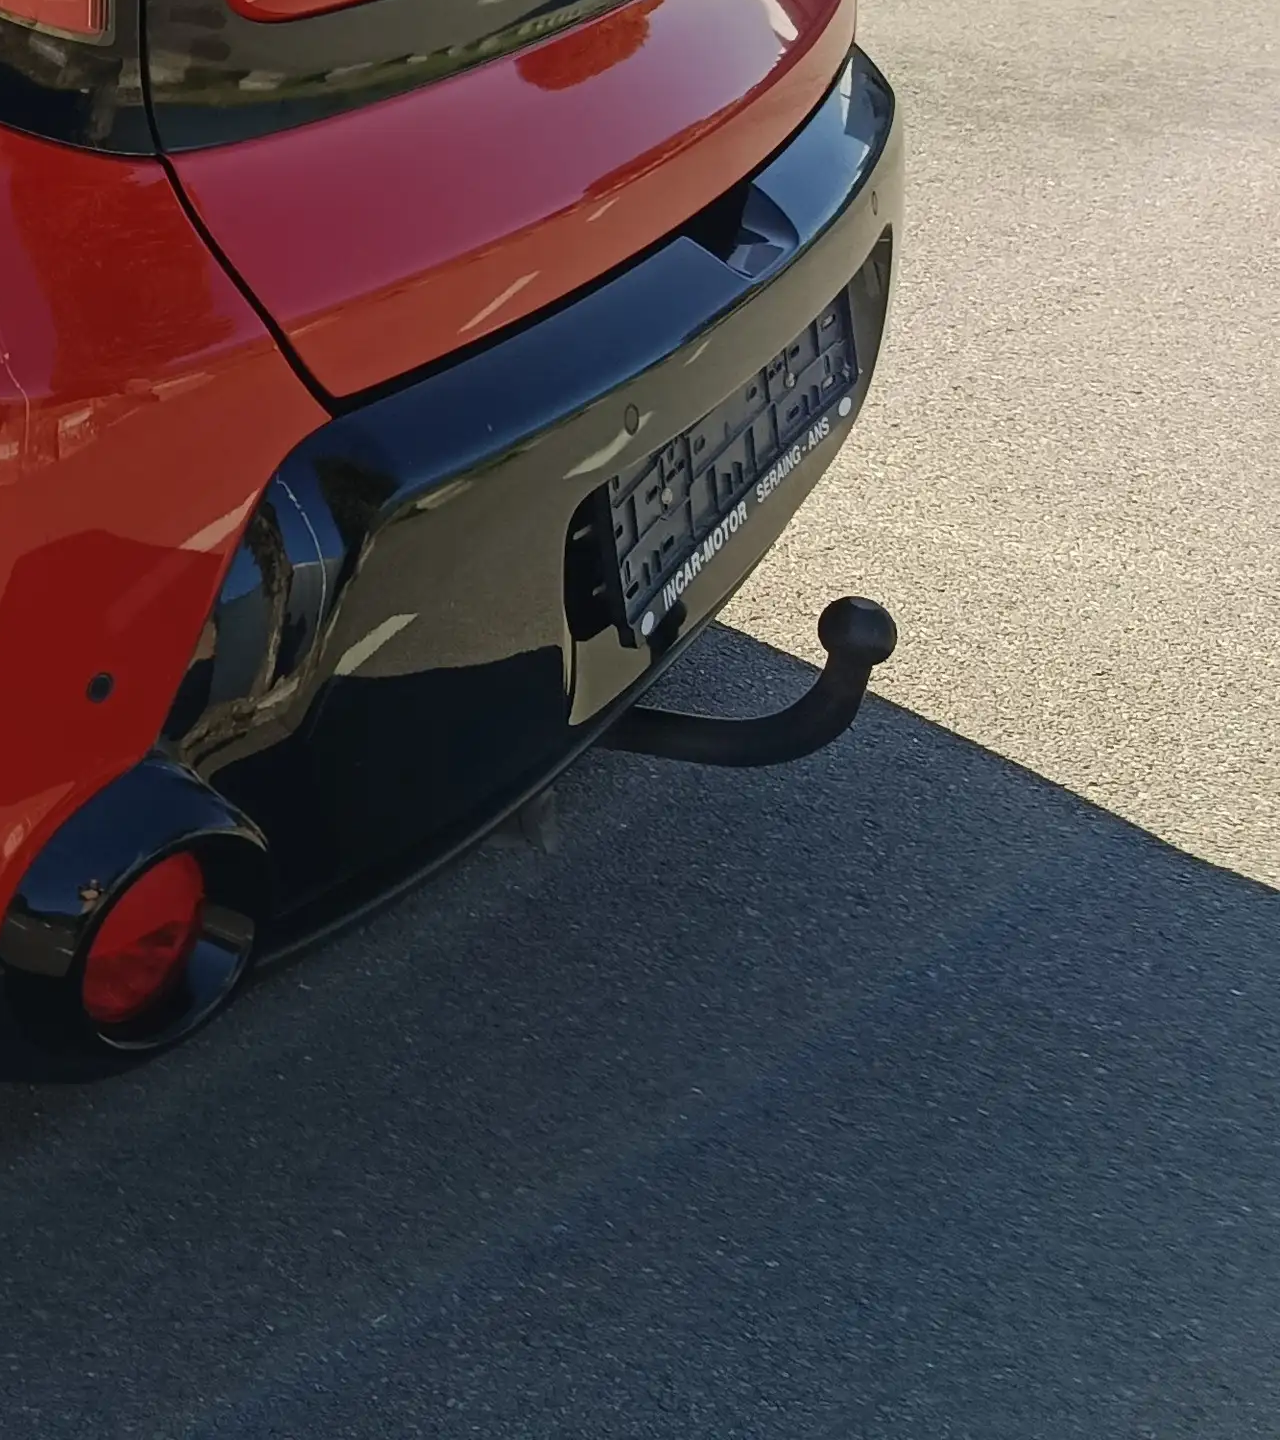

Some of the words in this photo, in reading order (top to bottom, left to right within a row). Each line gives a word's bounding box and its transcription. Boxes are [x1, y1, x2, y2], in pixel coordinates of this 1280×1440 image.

[663, 501, 748, 611] INCAR-MOTOR
[756, 445, 801, 503] SERAING
[808, 416, 830, 450] ANS
